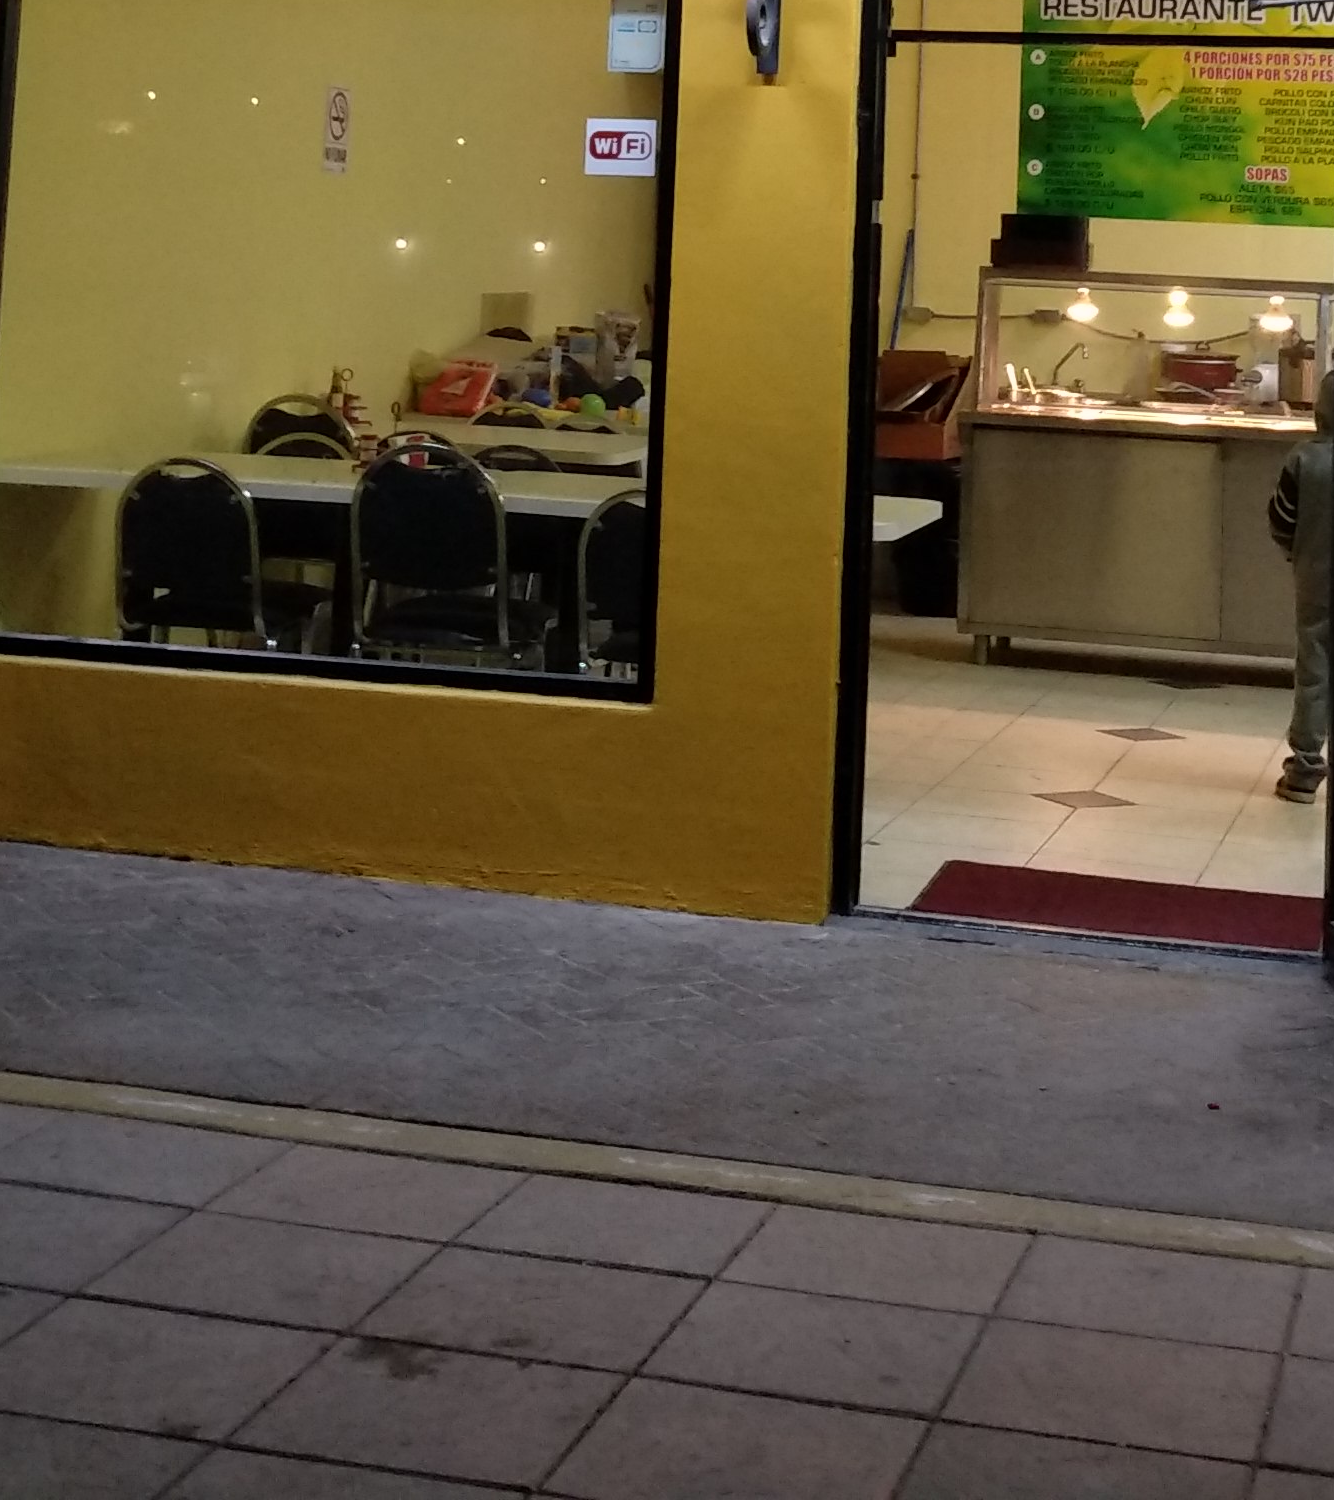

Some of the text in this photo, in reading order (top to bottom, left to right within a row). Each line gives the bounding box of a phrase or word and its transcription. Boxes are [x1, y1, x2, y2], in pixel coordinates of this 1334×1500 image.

[1183, 51, 1191, 64] 4
[1194, 51, 1263, 65] PORCIONES
[1267, 53, 1290, 66] POR
[1293, 53, 1316, 67] $75
[1199, 68, 1253, 80] PORCION
[1257, 68, 1280, 81] POR
[1284, 69, 1308, 82] $28
[1273, 89, 1304, 98] POLLO
[1306, 90, 1327, 98] CON
[593, 137, 645, 155] WiFi
[1246, 166, 1288, 182] SOPAS
